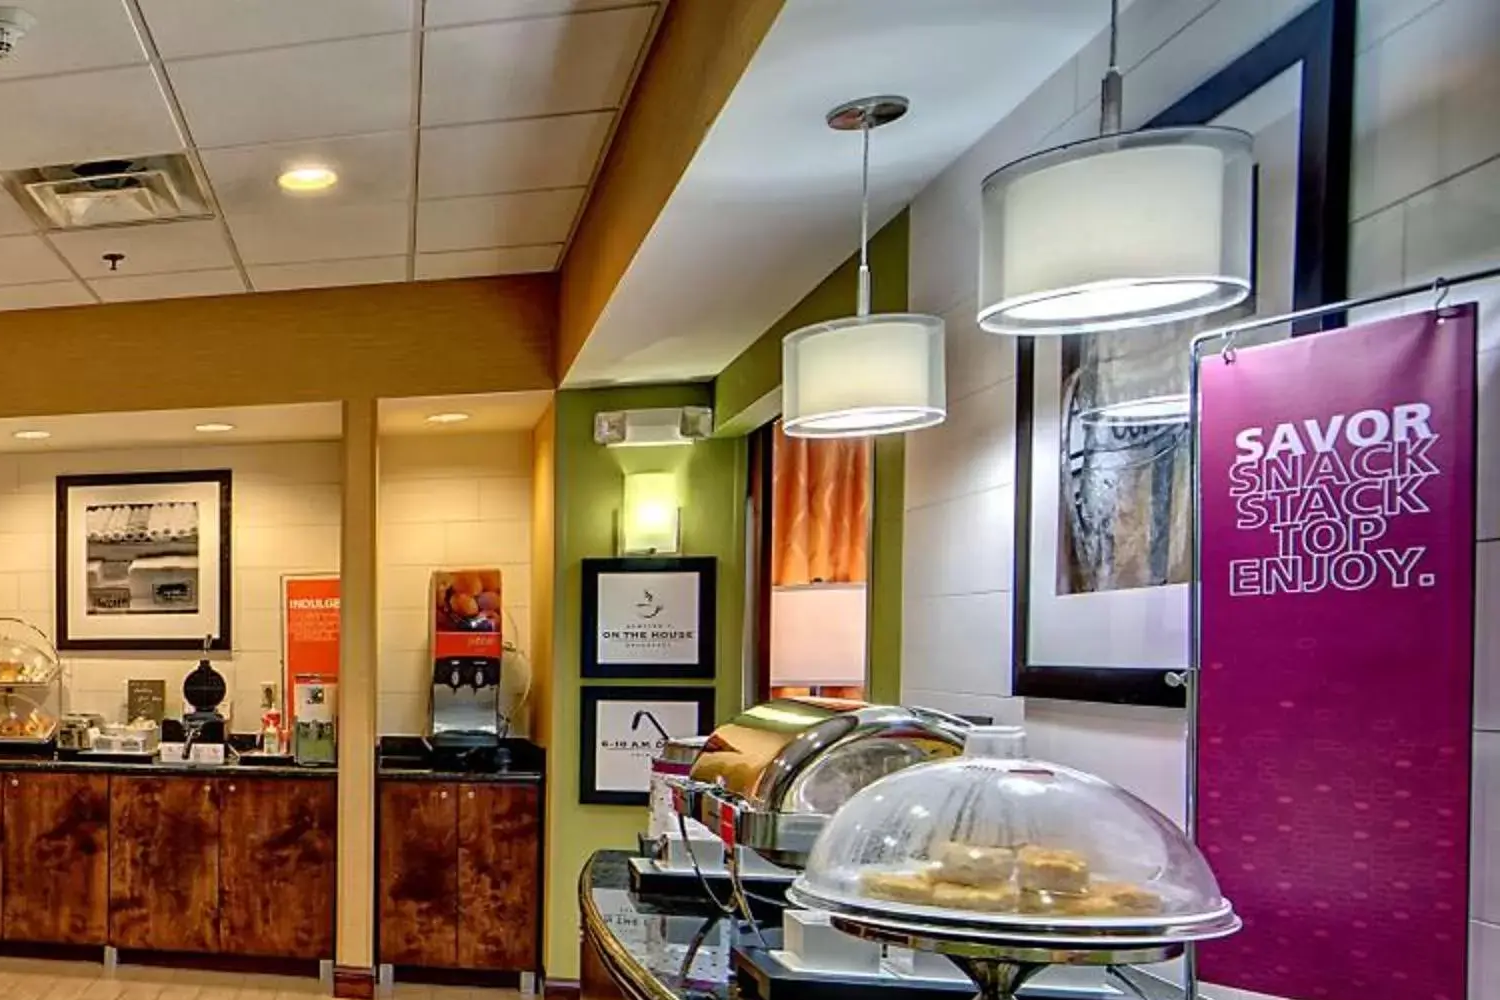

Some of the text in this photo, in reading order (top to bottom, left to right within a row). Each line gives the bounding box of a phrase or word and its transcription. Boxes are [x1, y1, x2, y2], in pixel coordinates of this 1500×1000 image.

[1234, 403, 1436, 462] SAVOR
[1229, 433, 1439, 497] SNACK
[1236, 474, 1431, 530] STACK
[1270, 514, 1387, 560] TOP
[1229, 546, 1436, 597] ENJOY.
[602, 630, 694, 639] ON THE HOUSE
